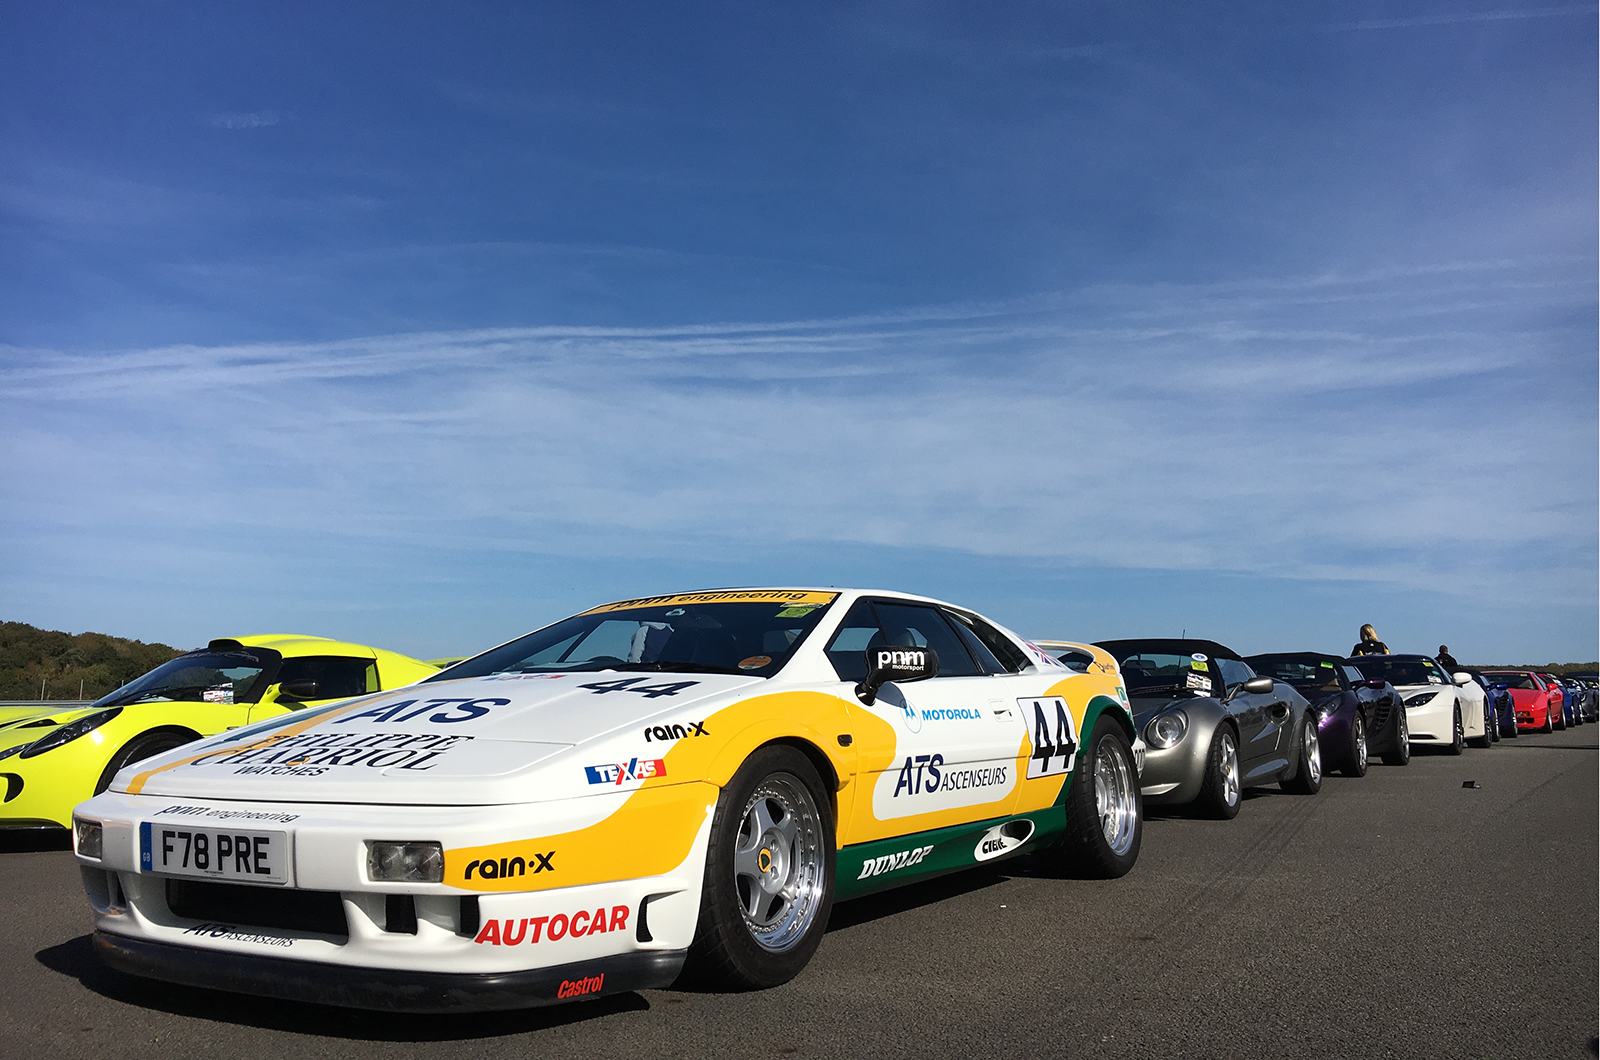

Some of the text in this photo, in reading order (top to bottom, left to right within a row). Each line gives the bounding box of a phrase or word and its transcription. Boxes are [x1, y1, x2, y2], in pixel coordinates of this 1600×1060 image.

[677, 590, 808, 601] engineering
[877, 650, 925, 670] pnm
[577, 677, 701, 698] 44
[330, 698, 512, 724] ATS
[922, 708, 981, 721] MOTOROLA
[247, 733, 475, 751] PHILIPPE
[1032, 700, 1077, 773] 44
[190, 747, 448, 771] CHARRIOL
[232, 766, 330, 777] WATCHES
[594, 758, 657, 785] TEXAS
[893, 753, 1007, 798] ATS ASCENSEURS
[154, 805, 300, 823] pnm engineering
[162, 830, 271, 875] F78 PRE
[857, 845, 934, 880] DUNLOP
[183, 923, 297, 948] ATS ASCENSEURS
[474, 905, 630, 946] AUTOCAR
[557, 973, 605, 999] Castrol
